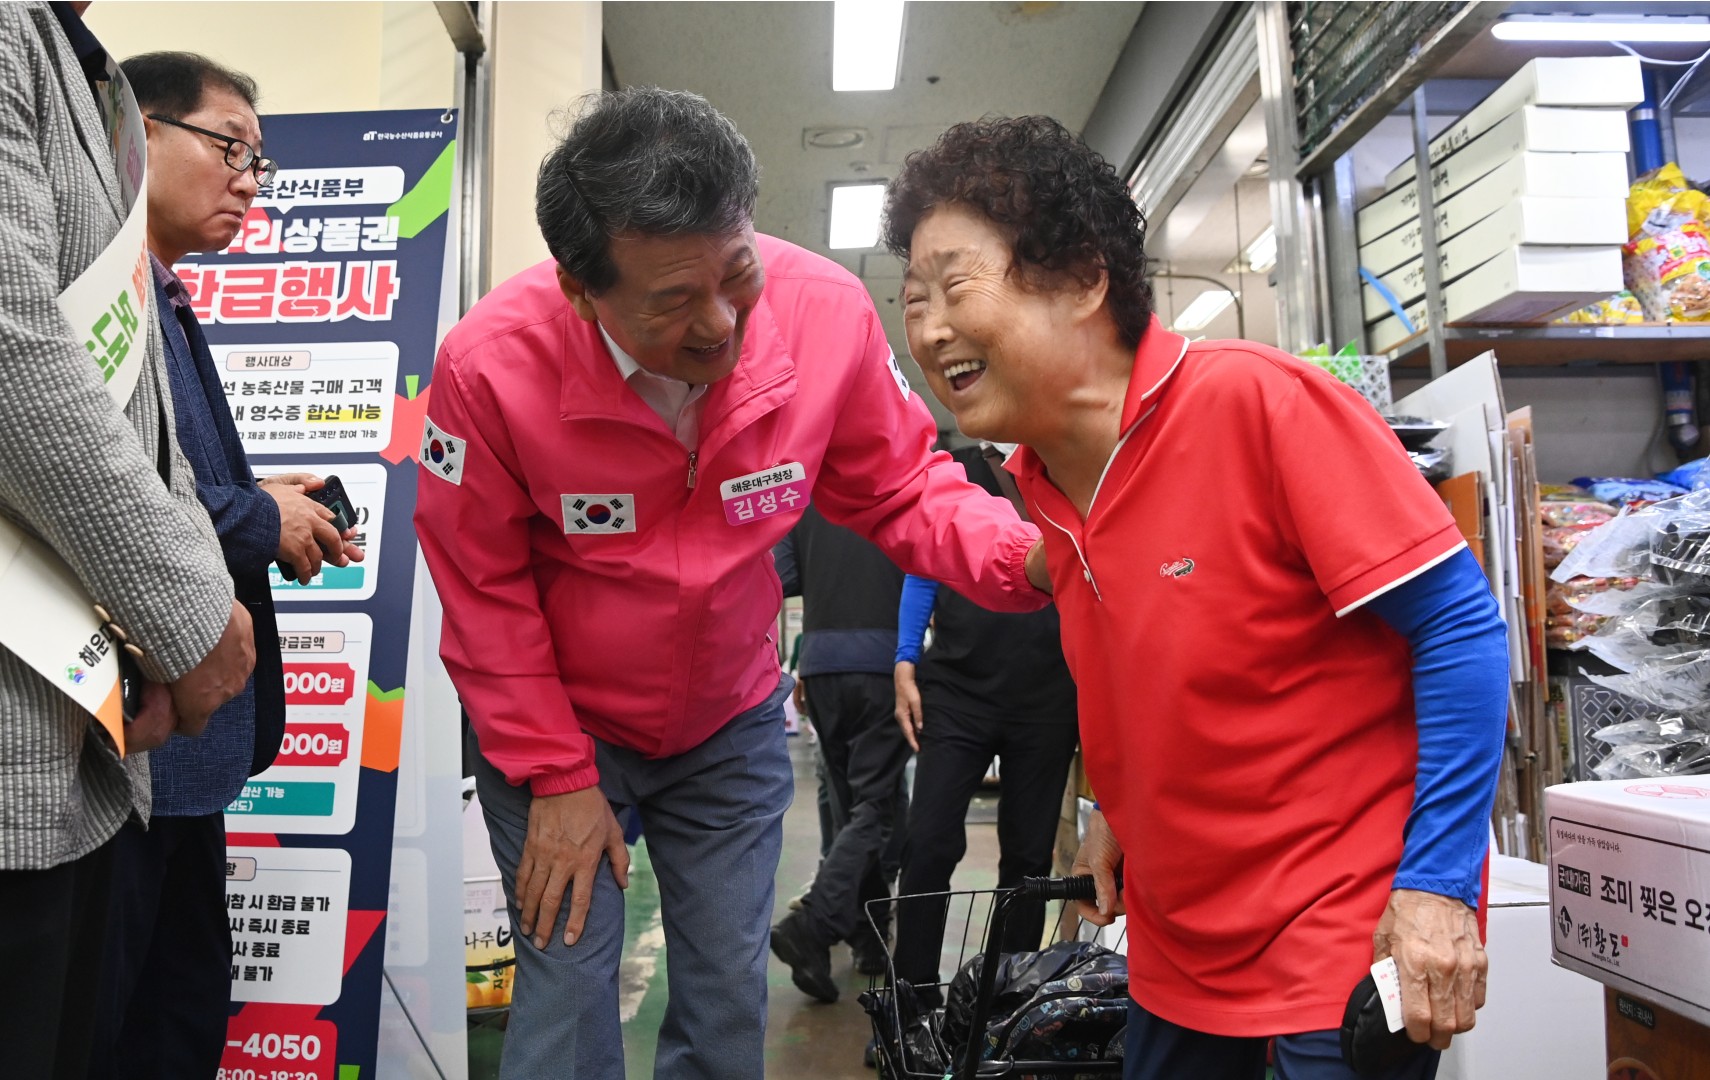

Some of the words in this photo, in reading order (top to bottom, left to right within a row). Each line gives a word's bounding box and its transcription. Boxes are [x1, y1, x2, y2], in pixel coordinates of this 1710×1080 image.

[245, 356, 293, 368] 행사대상
[241, 380, 304, 396] 농축산물
[310, 379, 343, 395] 구매
[348, 379, 383, 394] 고객
[250, 405, 301, 422] 영수증
[307, 404, 342, 421] 합산
[348, 403, 381, 420] 가능
[247, 431, 266, 440] 제공
[269, 431, 305, 440] 동의하는
[308, 430, 337, 439] 고객만
[361, 429, 378, 438] 가능
[730, 468, 793, 493] 해운대구청장
[733, 487, 801, 521] 김성수
[265, 786, 285, 799] 가능
[248, 894, 263, 910] 시
[267, 894, 296, 911] 환급
[301, 896, 330, 912] 불가
[1558, 865, 1592, 896] 국내가공
[1600, 874, 1633, 913] 조미
[1640, 885, 1677, 926] 찢은
[248, 918, 277, 934] 즉시
[281, 919, 310, 935] 종료
[251, 942, 280, 958] 종료
[244, 965, 273, 981] 불가
[227, 1033, 321, 1061] -4050
